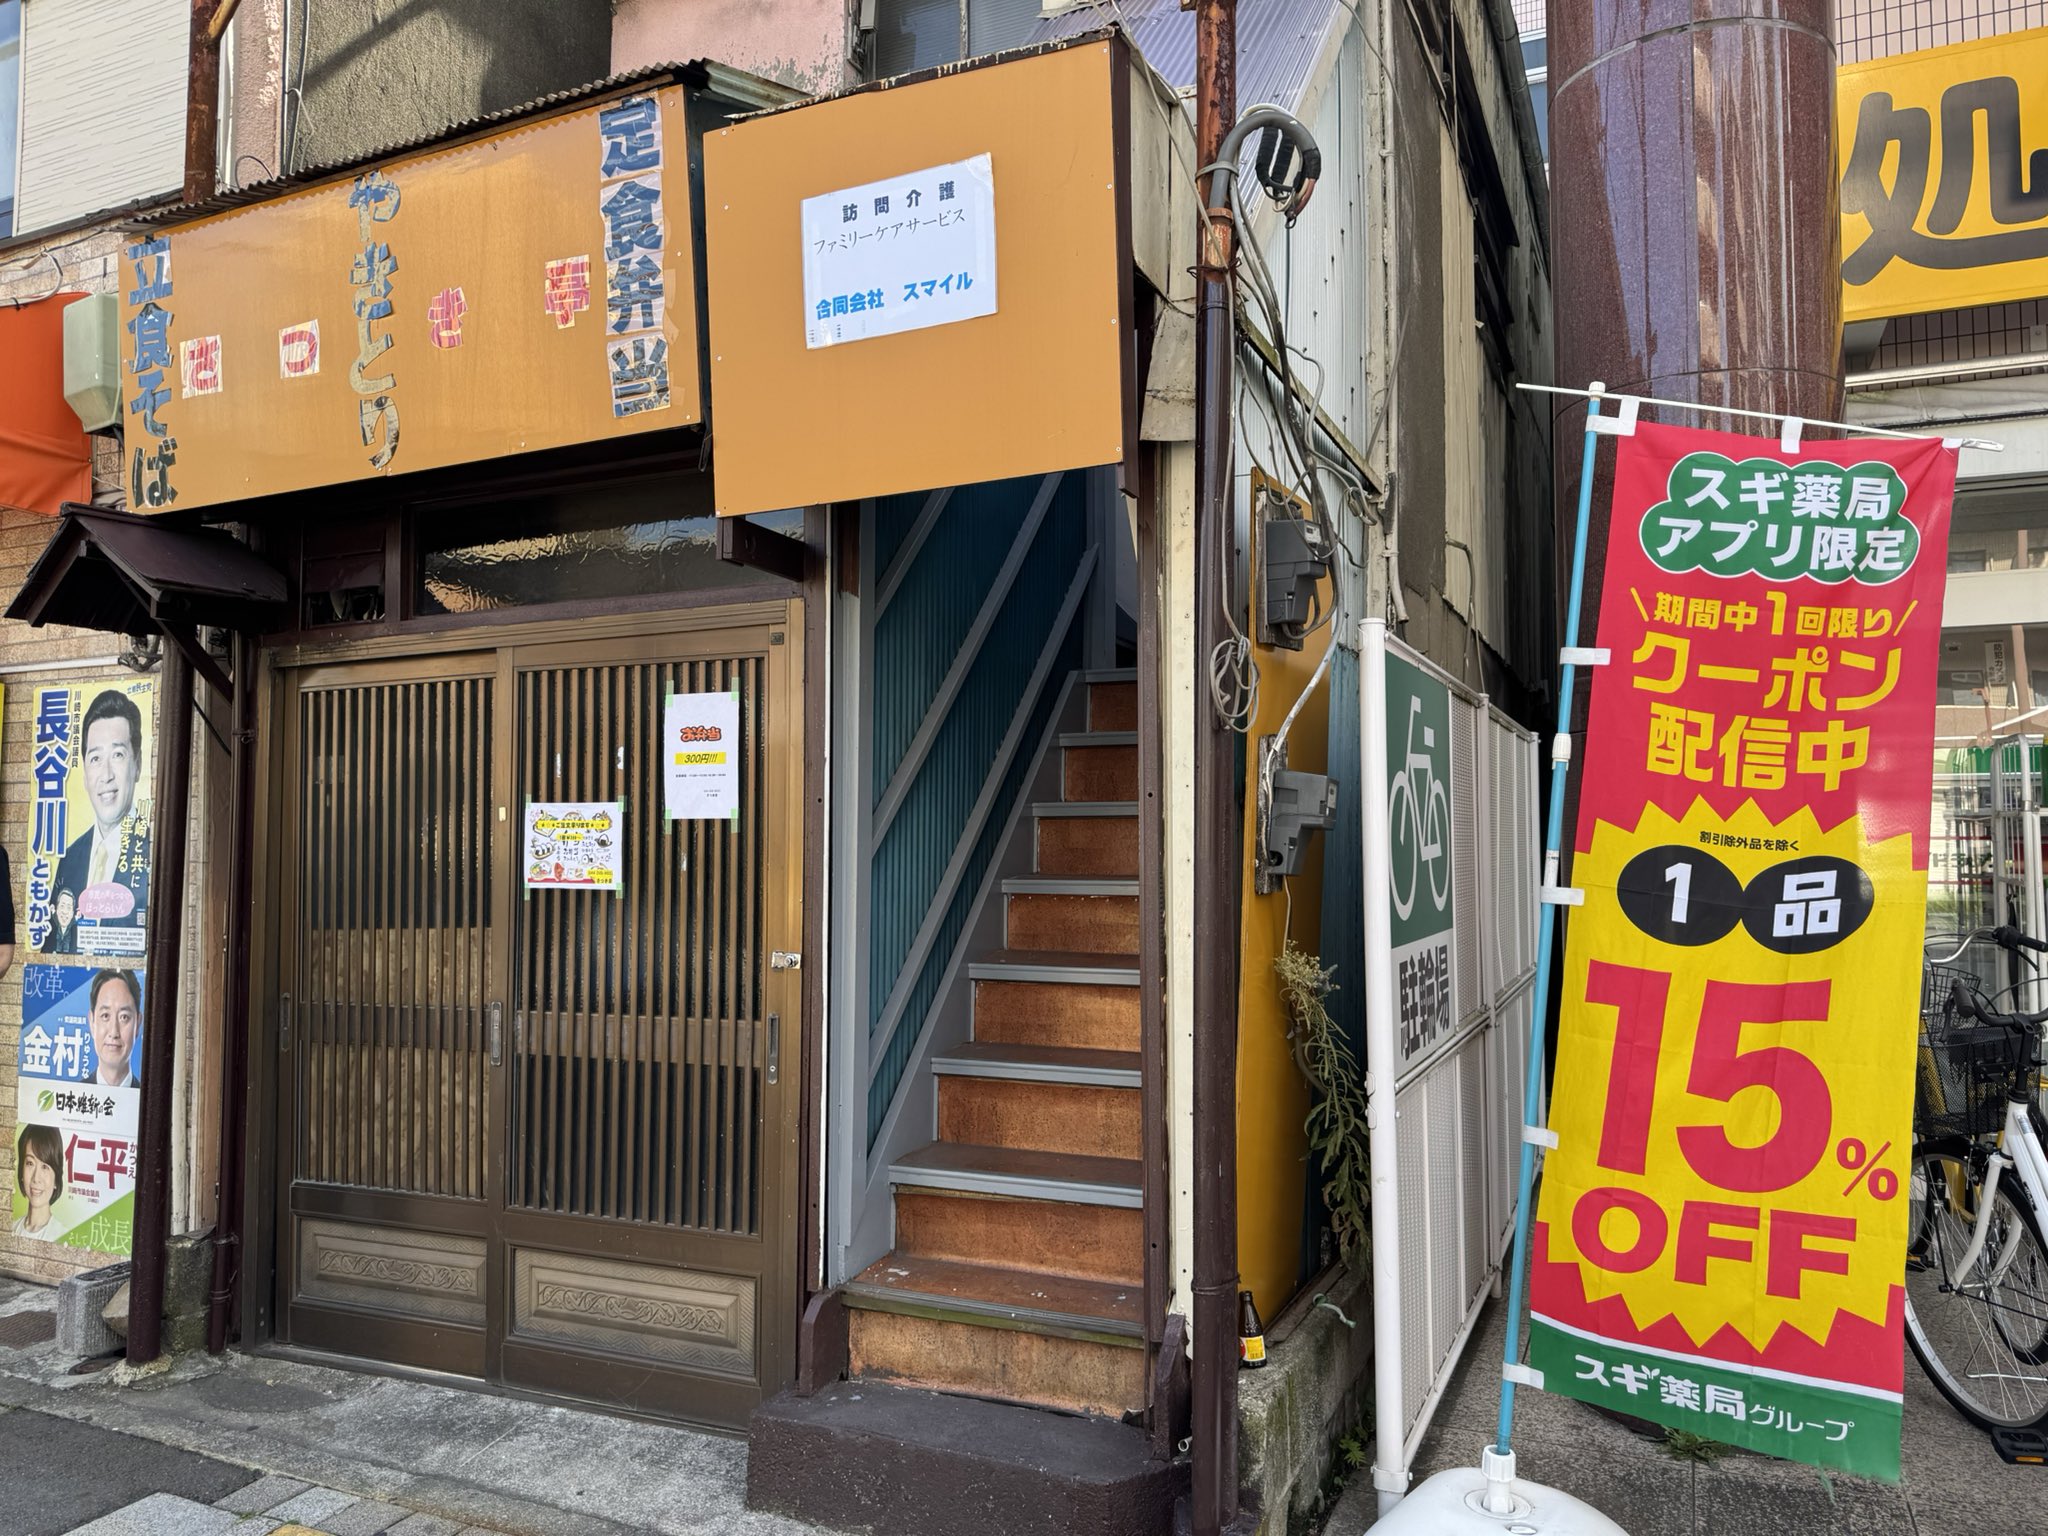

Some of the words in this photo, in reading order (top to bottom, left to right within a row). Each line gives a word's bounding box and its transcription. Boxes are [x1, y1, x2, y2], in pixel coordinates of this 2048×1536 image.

[842, 181, 955, 223] 訪問介護
[1840, 76, 2048, 286] 処
[599, 97, 670, 417] 定食弁当
[813, 208, 966, 255] ファミリーケアサービス
[349, 170, 401, 471] やきとり
[816, 288, 884, 320] 合同会社
[903, 272, 973, 302] スマイル
[128, 234, 178, 508] 立食そば
[1684, 467, 1892, 521] スギ薬局
[1656, 516, 1906, 572] アプリ限定
[1653, 591, 1893, 639] 期間中1回限り
[1632, 631, 1902, 712] クーポン
[680, 725, 722, 742] お弁当
[1646, 702, 1871, 792] 配信中
[29, 689, 71, 951] 長谷川ともかず
[118, 815, 133, 873] 生きる
[1699, 831, 1800, 852] 割引除外品を除く
[1399, 945, 1450, 1061] 駐輪場
[22, 1025, 83, 1077] 金村
[56, 1089, 115, 1118] 日本維新の会
[65, 1134, 128, 1189] 仁平
[1571, 1187, 1857, 1300] OFF
[1575, 1354, 1855, 1441] スギ薬局グループ
